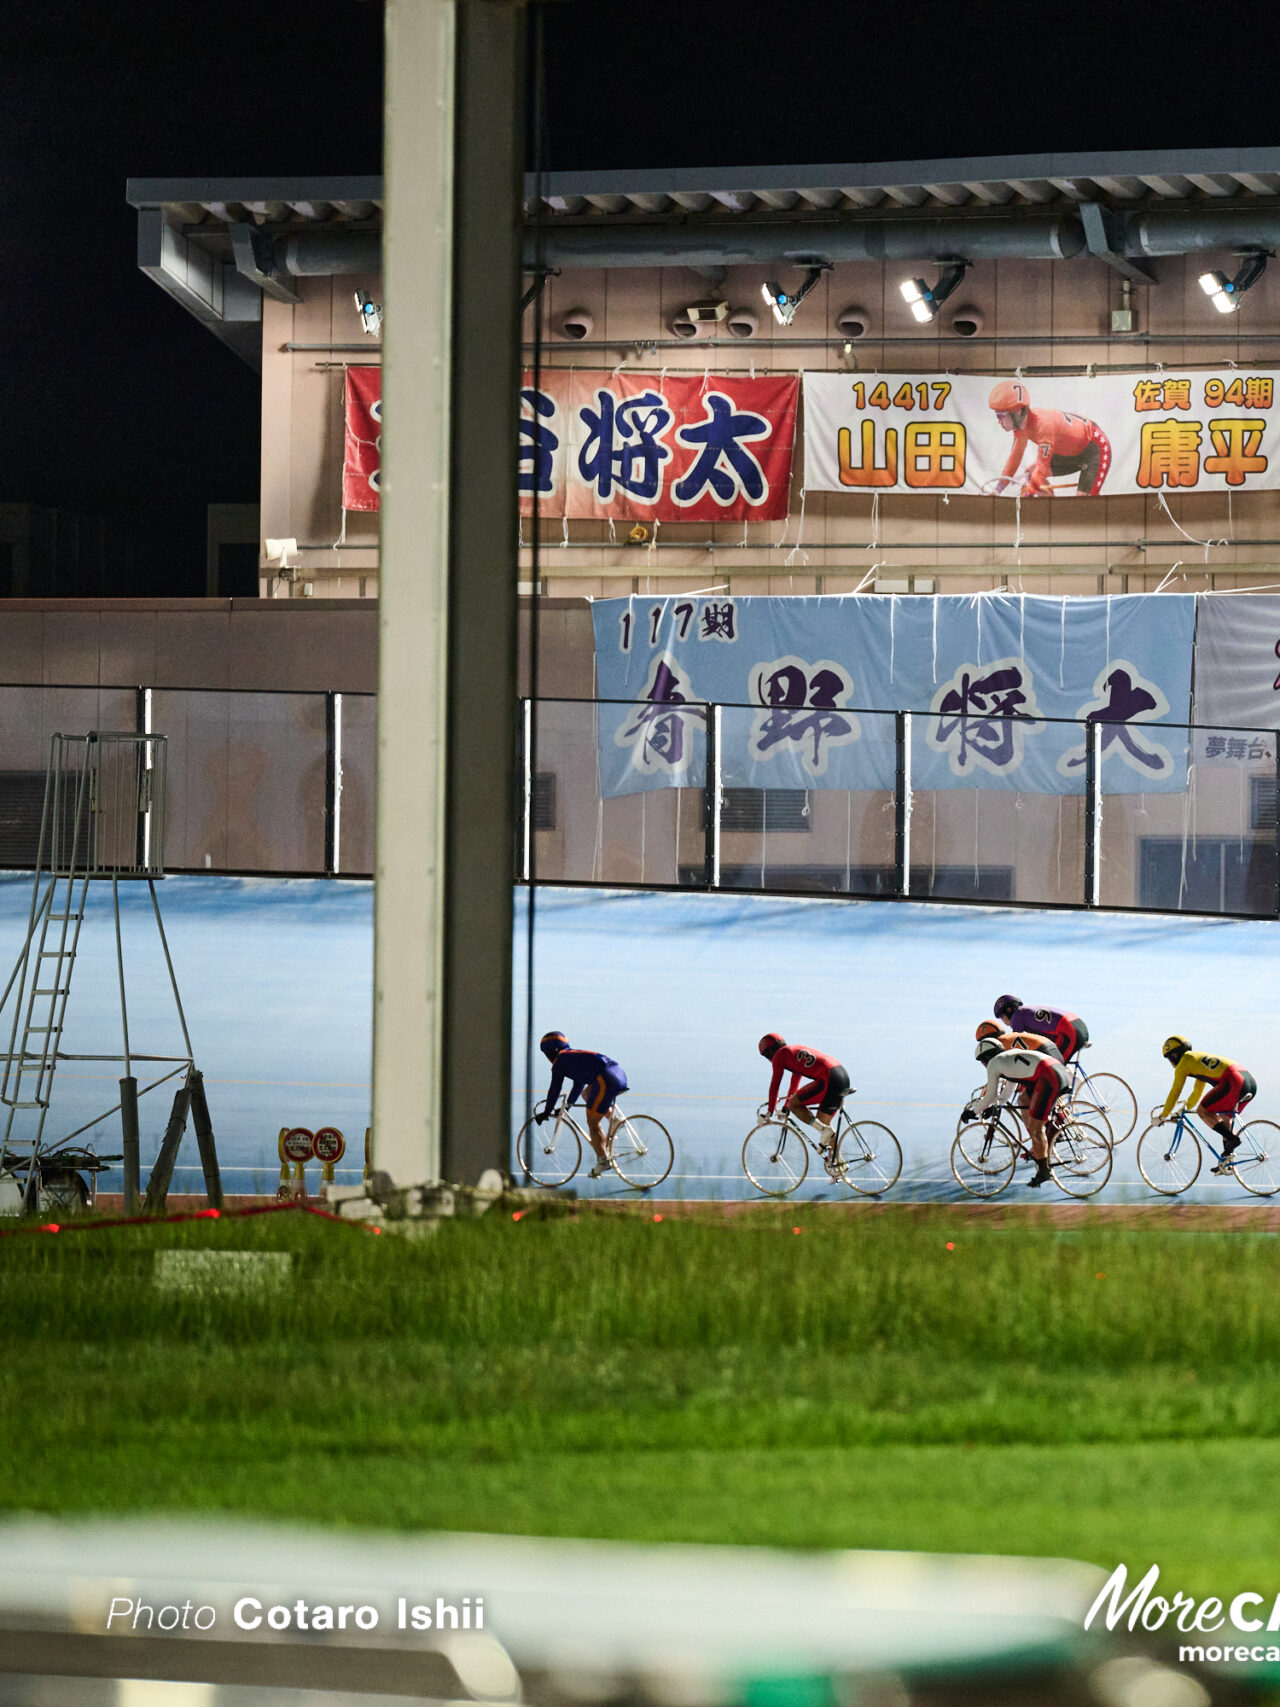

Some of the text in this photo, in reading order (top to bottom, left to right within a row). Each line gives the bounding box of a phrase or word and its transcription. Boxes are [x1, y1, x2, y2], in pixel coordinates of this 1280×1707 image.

[852, 381, 952, 411] 14417
[1132, 377, 1275, 412] 佐賀 94期
[836, 419, 968, 489] 山田
[1135, 418, 1270, 488] 庸平
[621, 602, 737, 651] 117期
